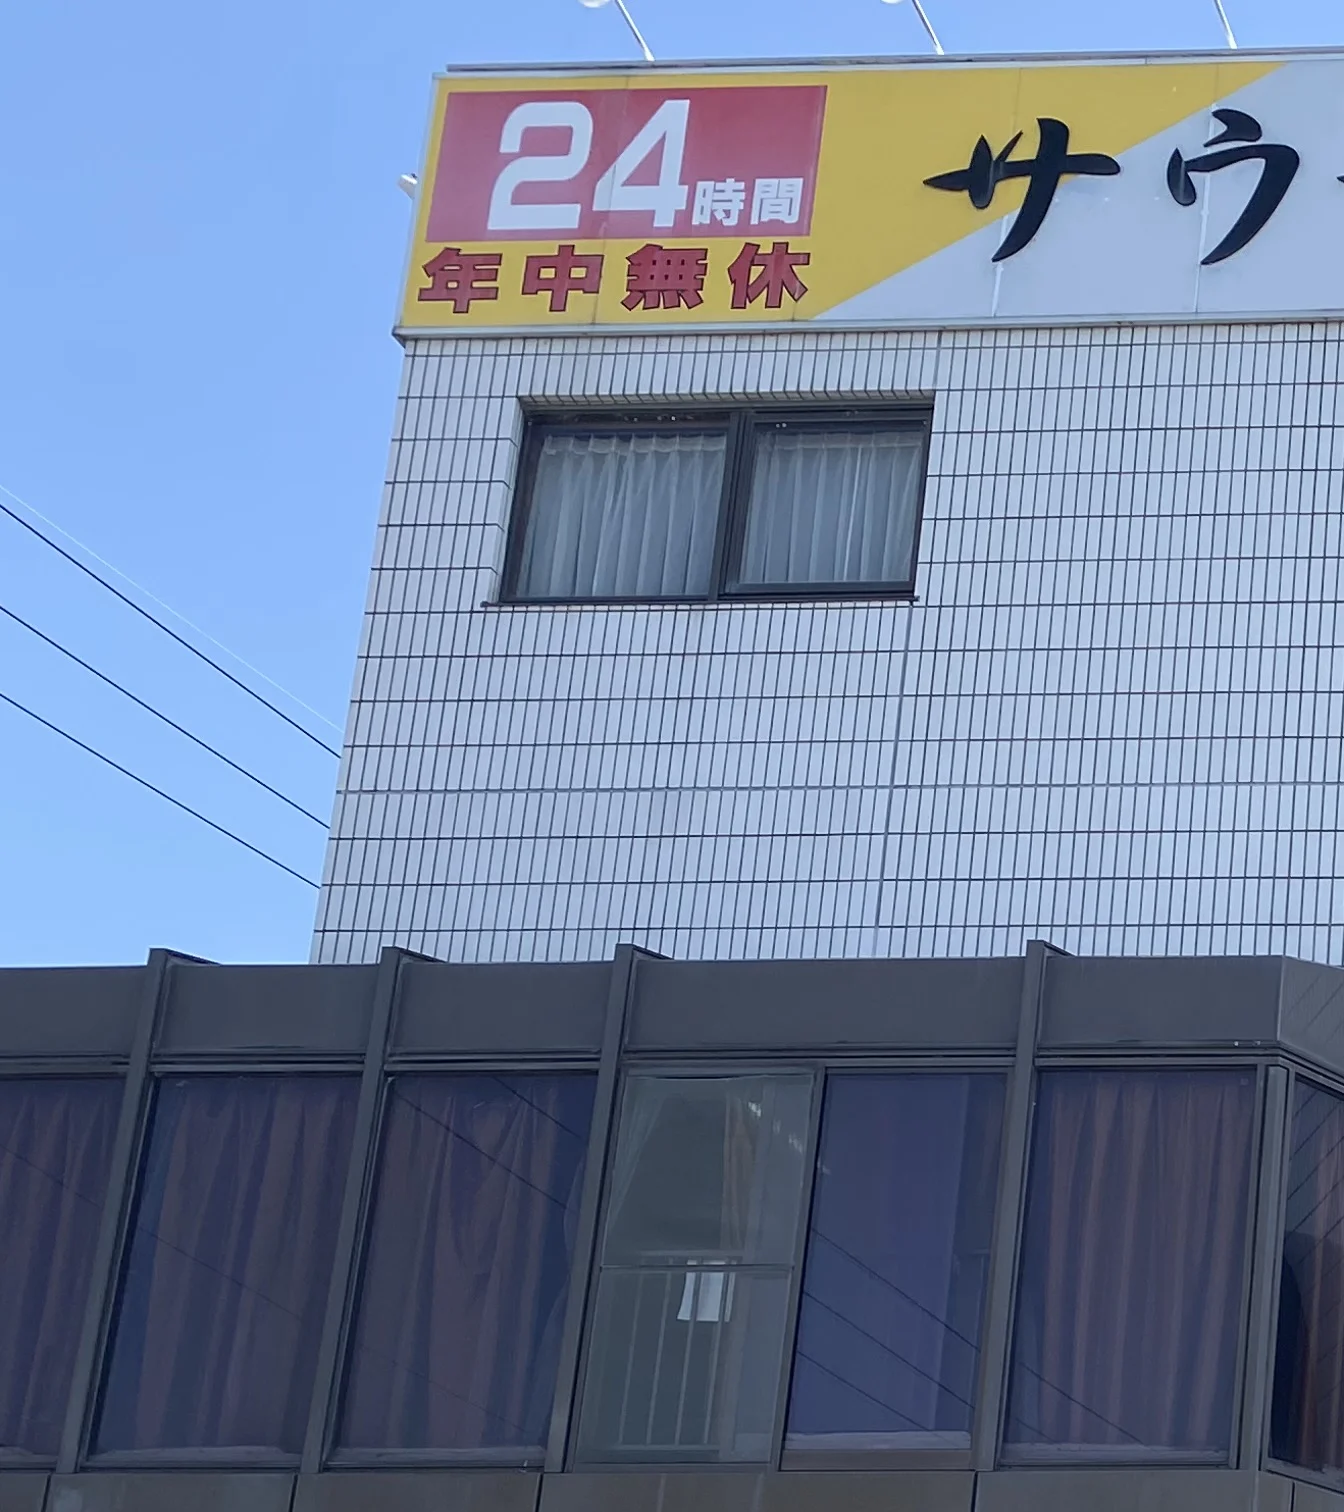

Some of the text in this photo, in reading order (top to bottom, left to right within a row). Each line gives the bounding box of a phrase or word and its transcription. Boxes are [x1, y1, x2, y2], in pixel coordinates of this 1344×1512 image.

[486, 98, 804, 231] 24時間
[417, 243, 811, 314] 年中無休
